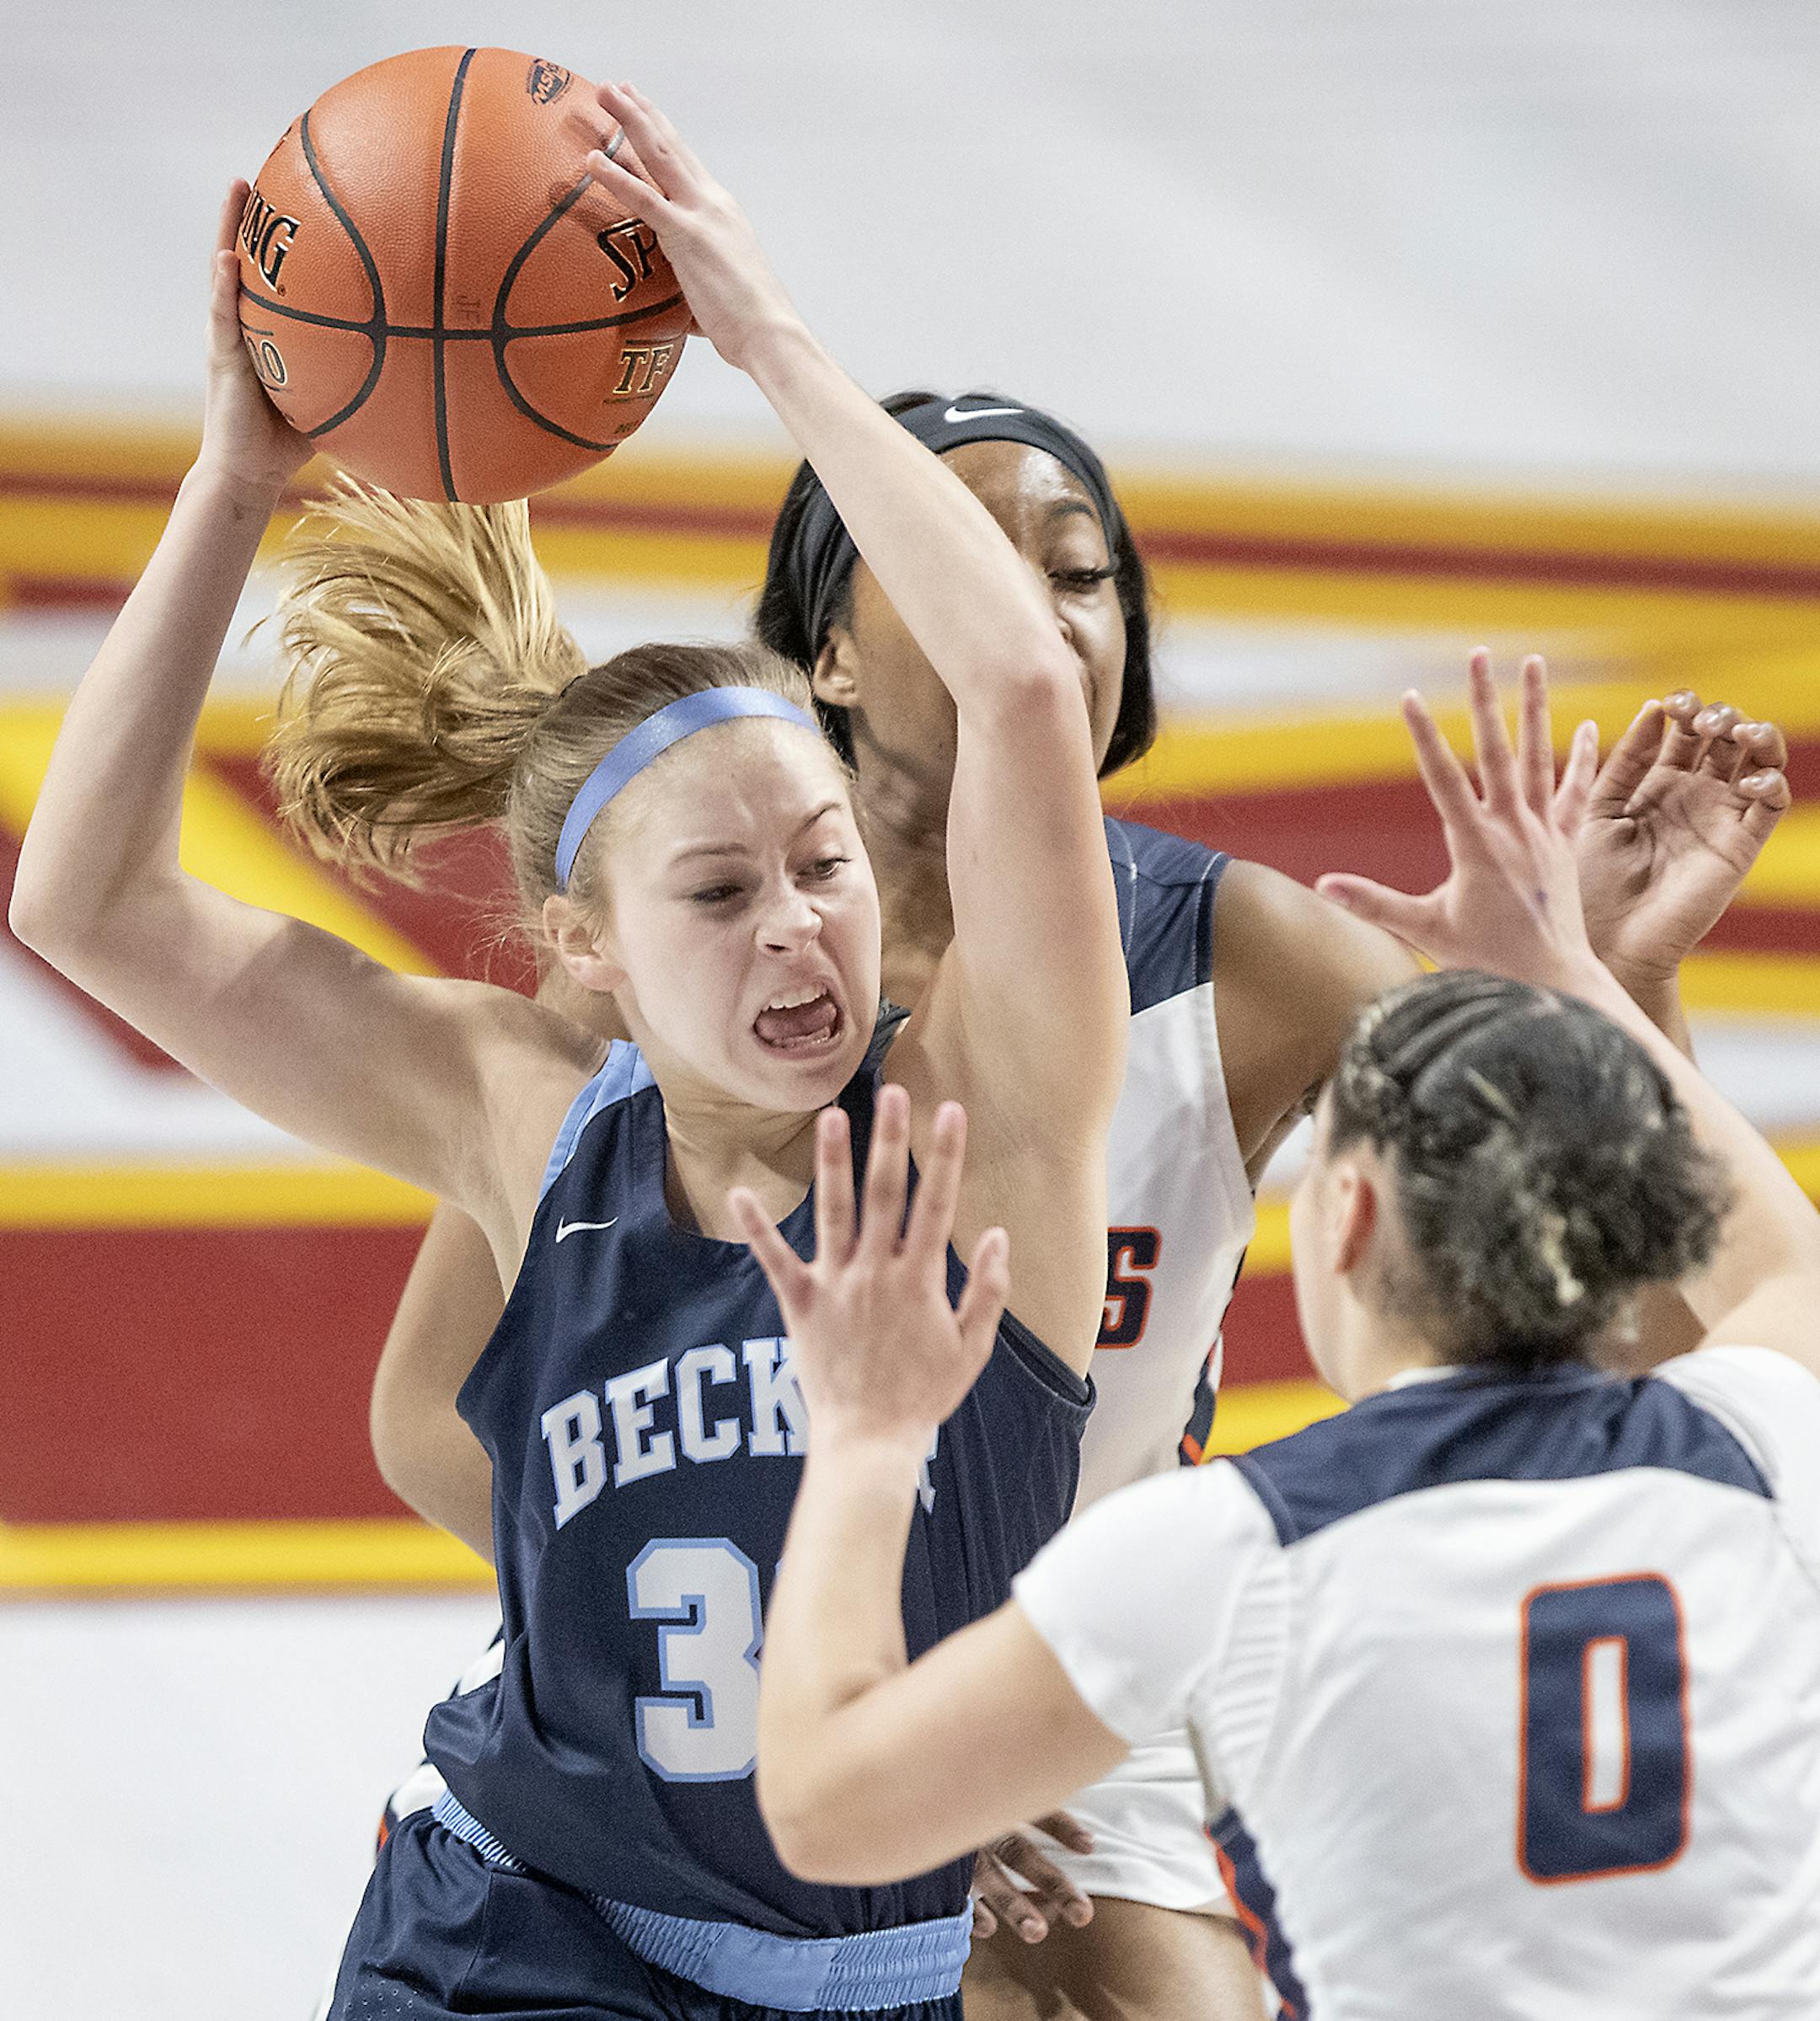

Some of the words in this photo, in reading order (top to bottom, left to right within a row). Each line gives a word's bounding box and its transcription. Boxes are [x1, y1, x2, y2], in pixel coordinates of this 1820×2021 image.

[541, 1335, 939, 1531] BECK
[626, 1537, 784, 1782] 3
[1516, 1570, 1694, 1887] 0
